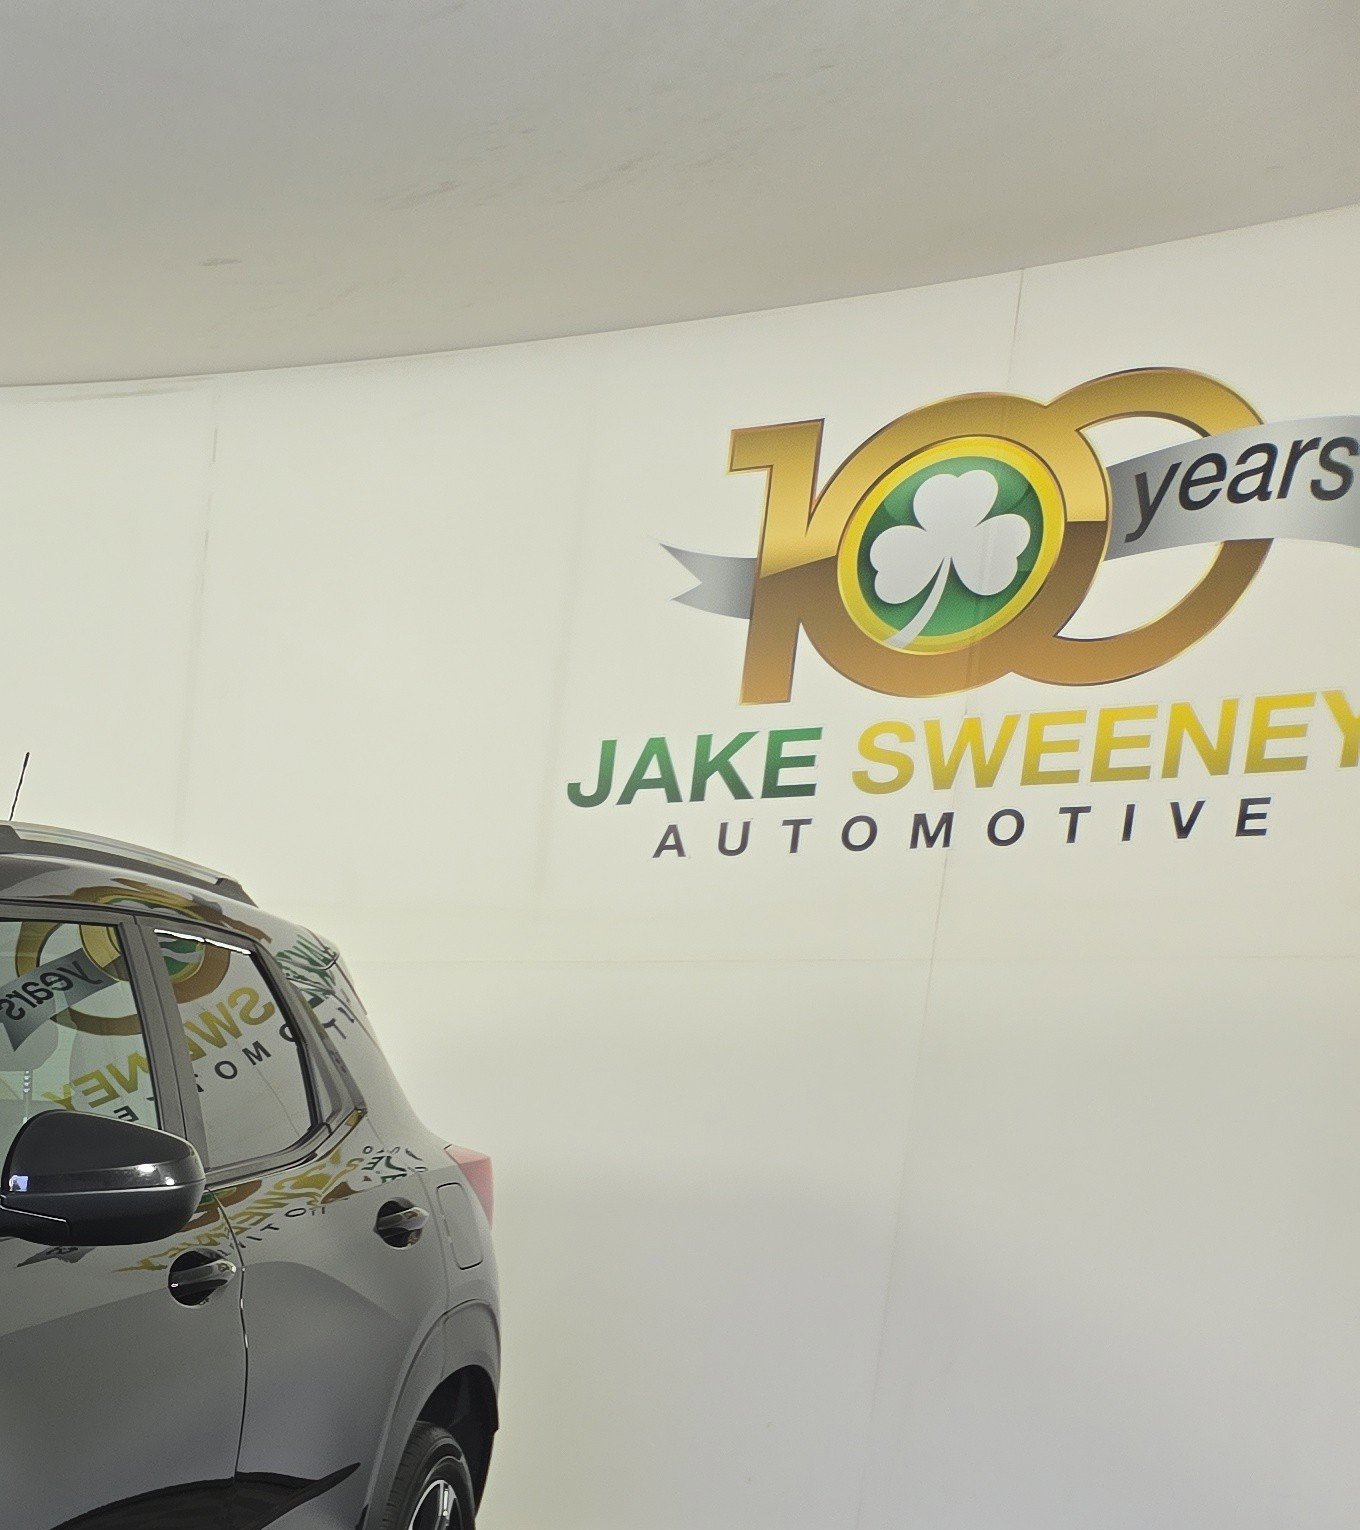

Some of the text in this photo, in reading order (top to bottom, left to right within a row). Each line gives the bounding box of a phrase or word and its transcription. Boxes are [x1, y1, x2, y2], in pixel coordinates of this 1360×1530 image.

[1125, 435, 1360, 543] years
[566, 726, 823, 808] JAKE
[653, 796, 1272, 859] AUTOMOTIVE
